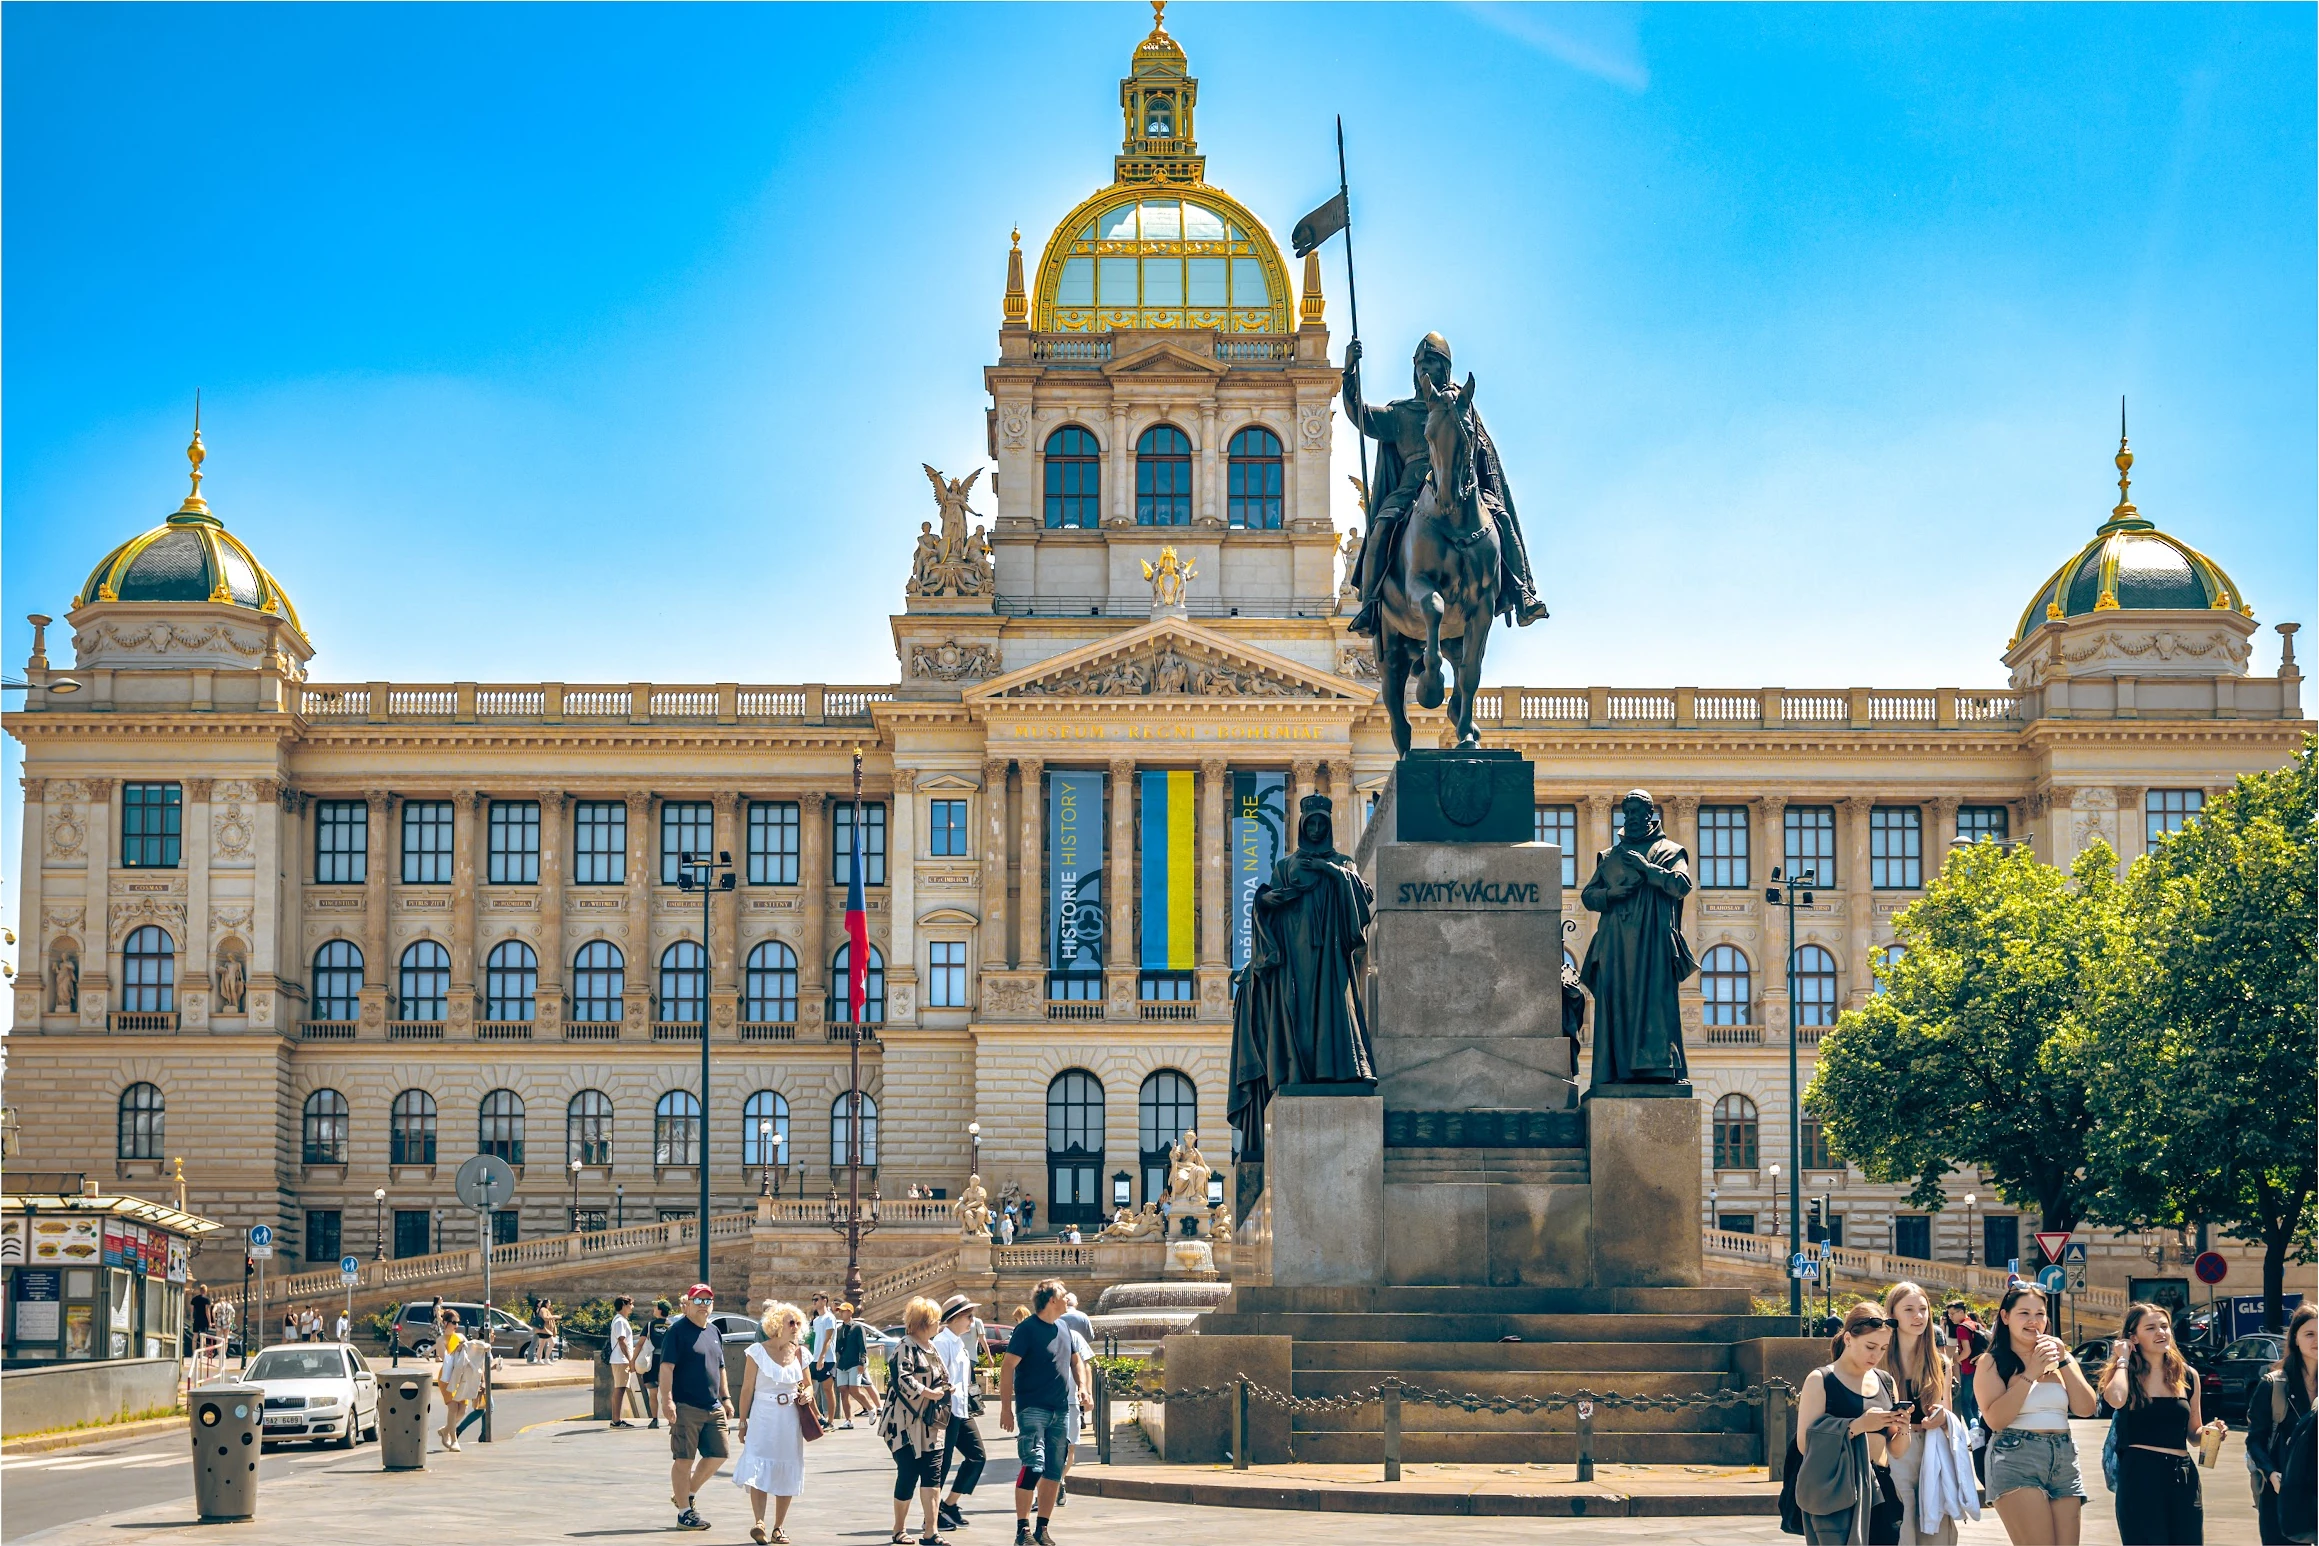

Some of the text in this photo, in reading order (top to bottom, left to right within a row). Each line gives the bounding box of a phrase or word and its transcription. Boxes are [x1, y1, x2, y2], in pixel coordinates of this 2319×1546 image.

[1014, 725, 1324, 740] MUSEUM REGNI BOHEMIAE
[1243, 795, 1259, 871] NATURE
[1061, 782, 1077, 959] HISTORIE HISTORY
[1461, 878, 1539, 903] VÁCLAVE
[2238, 1302, 2265, 1314] GLS
